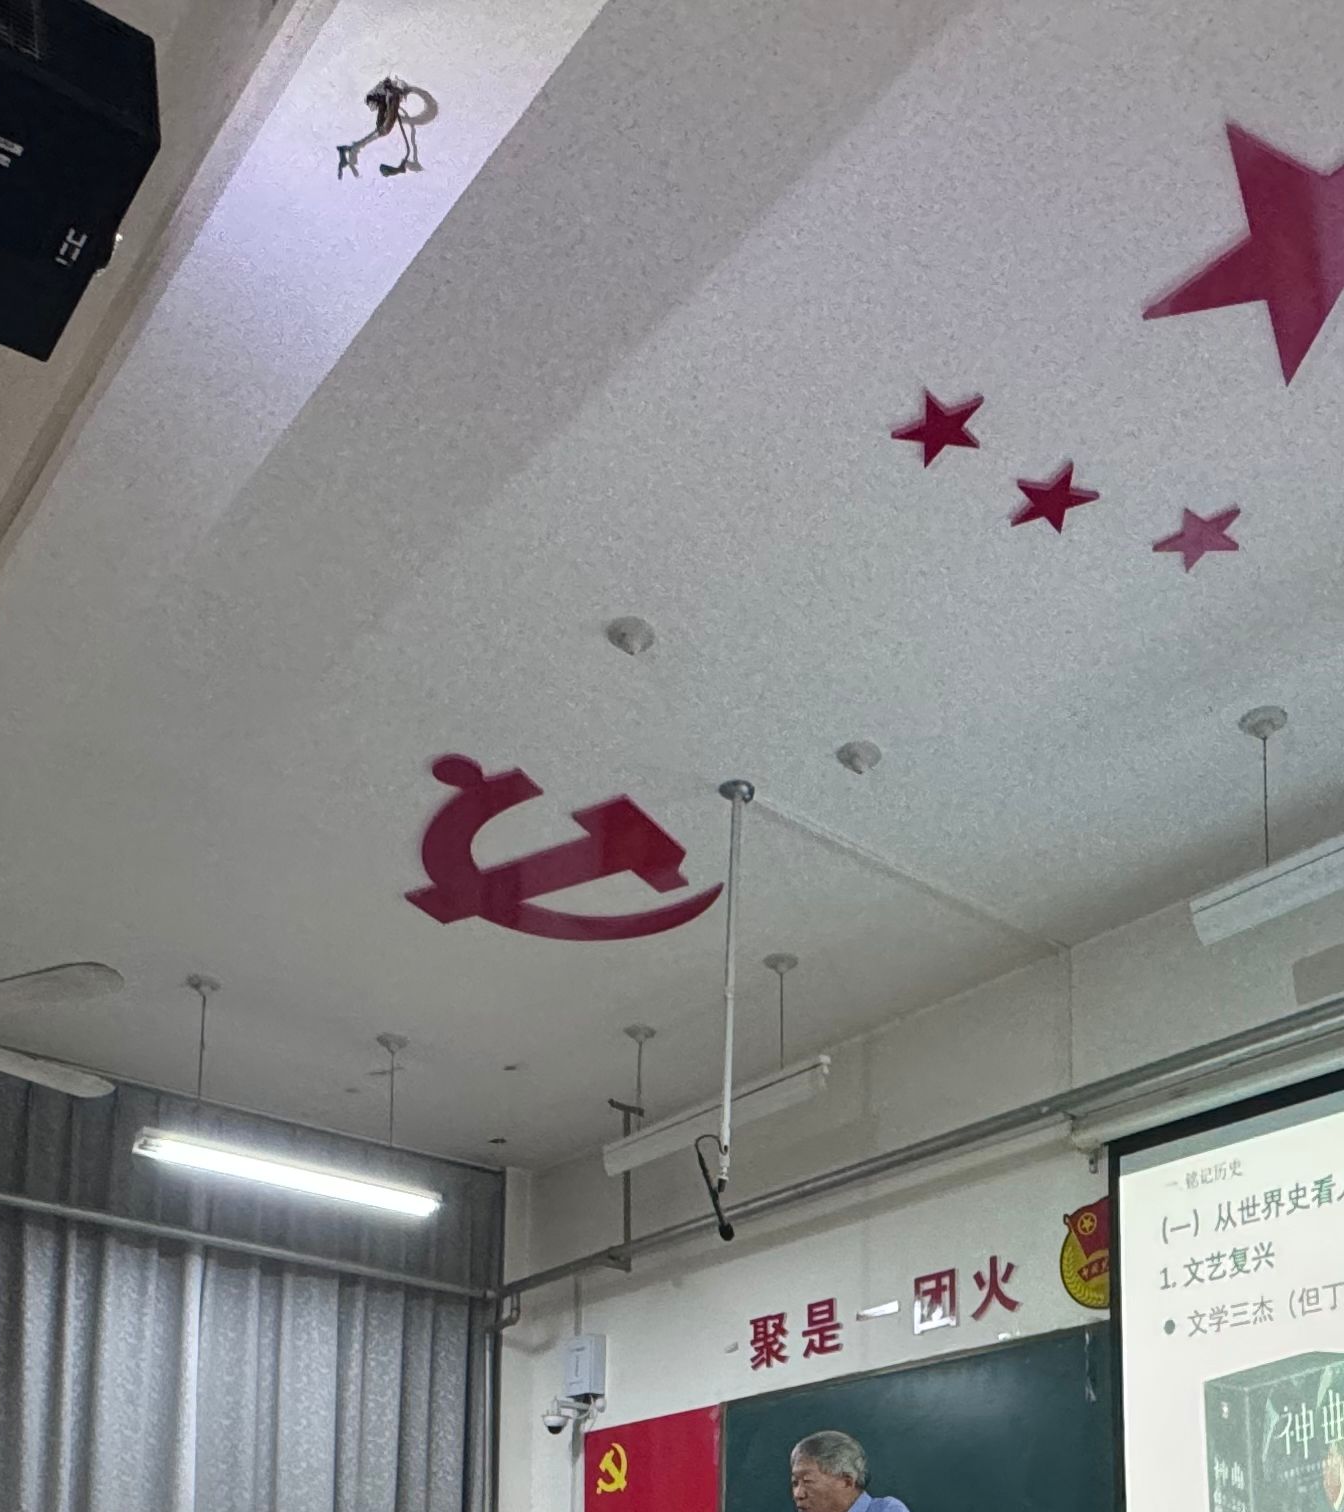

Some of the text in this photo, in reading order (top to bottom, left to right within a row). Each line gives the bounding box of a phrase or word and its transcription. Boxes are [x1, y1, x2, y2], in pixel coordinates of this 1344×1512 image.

[749, 1254, 1023, 1371] 聚是一团火
